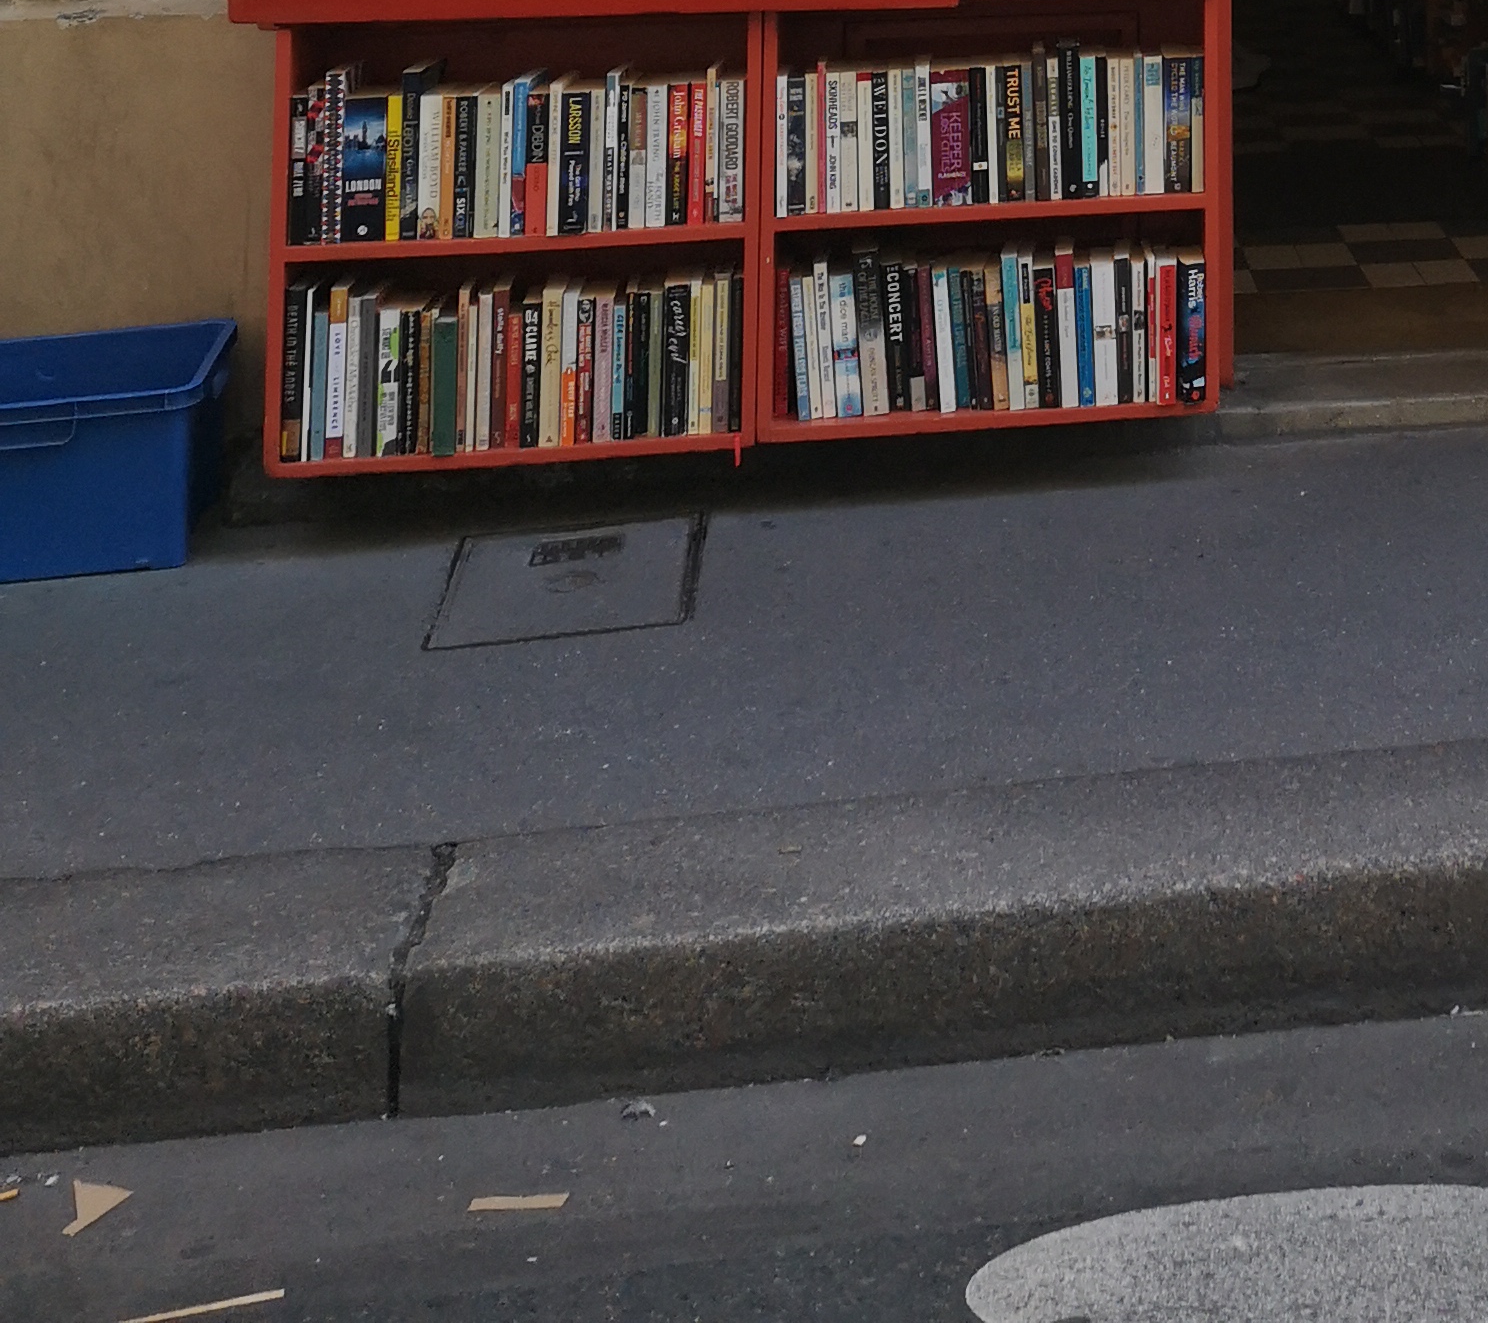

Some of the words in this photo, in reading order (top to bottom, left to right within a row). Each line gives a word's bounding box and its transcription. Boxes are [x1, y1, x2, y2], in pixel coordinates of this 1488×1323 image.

[673, 91, 684, 114] John
[694, 89, 703, 99] THE
[725, 81, 739, 120] ROBERT
[828, 80, 838, 130] SKINHEADS
[1007, 69, 1019, 114] TRUST
[460, 100, 468, 132] ROBERT
[568, 97, 582, 144] LARSSON
[693, 101, 703, 137] PASSENGER
[874, 84, 887, 165] WELDON
[941, 113, 949, 139] LOST
[1009, 117, 1020, 139] ME
[403, 121, 418, 156] Leon
[430, 111, 441, 162] WILLIAM
[673, 117, 685, 158] Grisham
[725, 123, 739, 170] GODDARD
[950, 112, 962, 170] KEEPER
[388, 139, 400, 197] Stasiland
[459, 142, 467, 172] PARKER
[829, 154, 837, 172] JOHN
[941, 140, 950, 173] CITIES
[345, 179, 381, 193] LONDON
[430, 163, 440, 199] BOYD
[829, 174, 837, 189] KING
[456, 197, 465, 215] SIX
[839, 283, 847, 298] the
[1187, 269, 1198, 309] Harris
[287, 305, 298, 334] DEATH
[671, 300, 686, 336] career
[840, 300, 848, 320] dice
[886, 272, 902, 342] CONCERT
[525, 326, 537, 362] CLARKE
[841, 322, 849, 343] man
[286, 350, 297, 367] THE
[667, 338, 688, 363] evil
[331, 376, 340, 430] LIMERENCE
